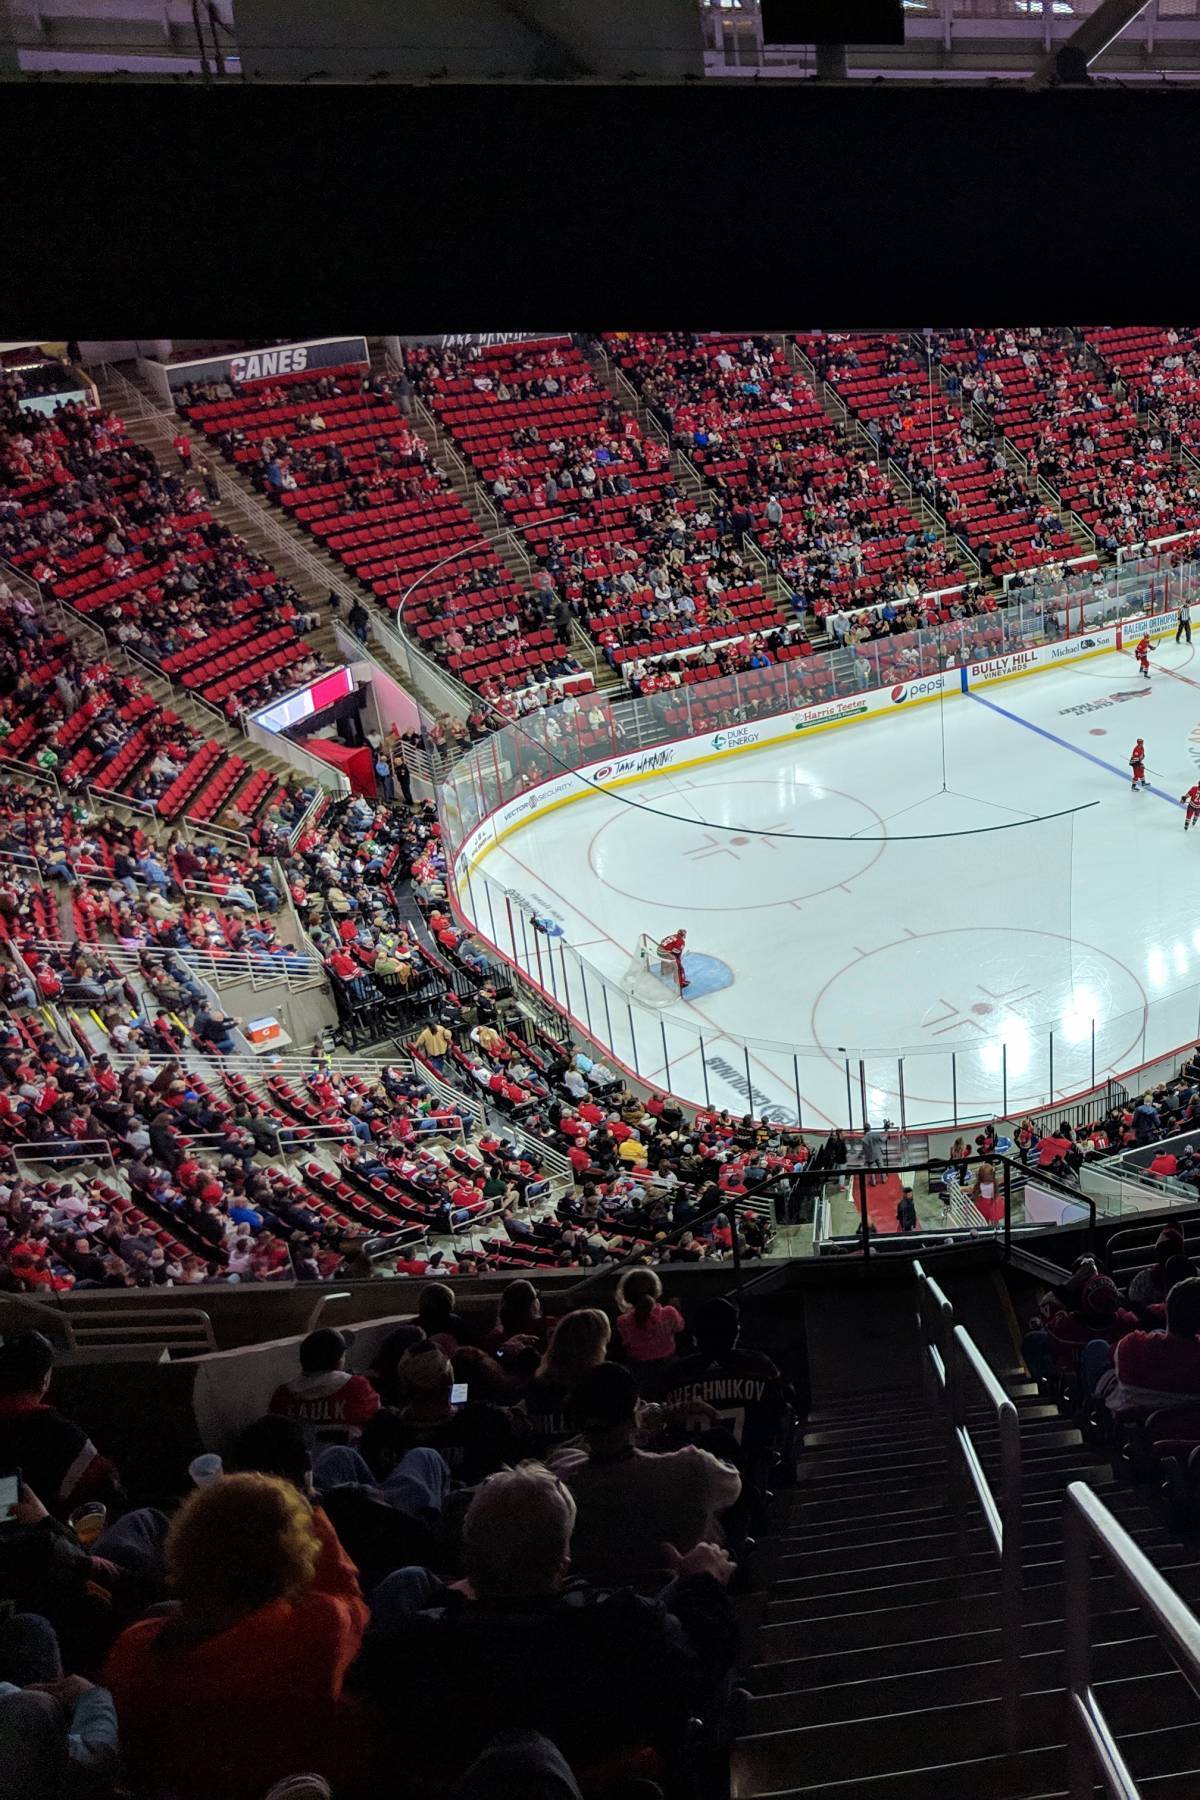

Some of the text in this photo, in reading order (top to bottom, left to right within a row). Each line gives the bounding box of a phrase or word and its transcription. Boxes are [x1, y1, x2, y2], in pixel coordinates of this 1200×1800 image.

[230, 347, 308, 383] CANES
[1124, 612, 1178, 635] RALEIGH ORTHOPAE
[1051, 636, 1110, 659] Michael Son
[972, 651, 1038, 677] BULLY HILL
[984, 662, 1028, 680] VINEYARDS
[910, 675, 946, 699] pepsi
[804, 706, 835, 721] Harris
[837, 699, 866, 712] Teeter
[728, 727, 749, 739] DUKE
[728, 733, 759, 749] ENERGY
[614, 748, 674, 774] TAKE WARNING
[504, 781, 573, 821] VECTOR SECURITY
[705, 1056, 772, 1107] CAROLINAS
